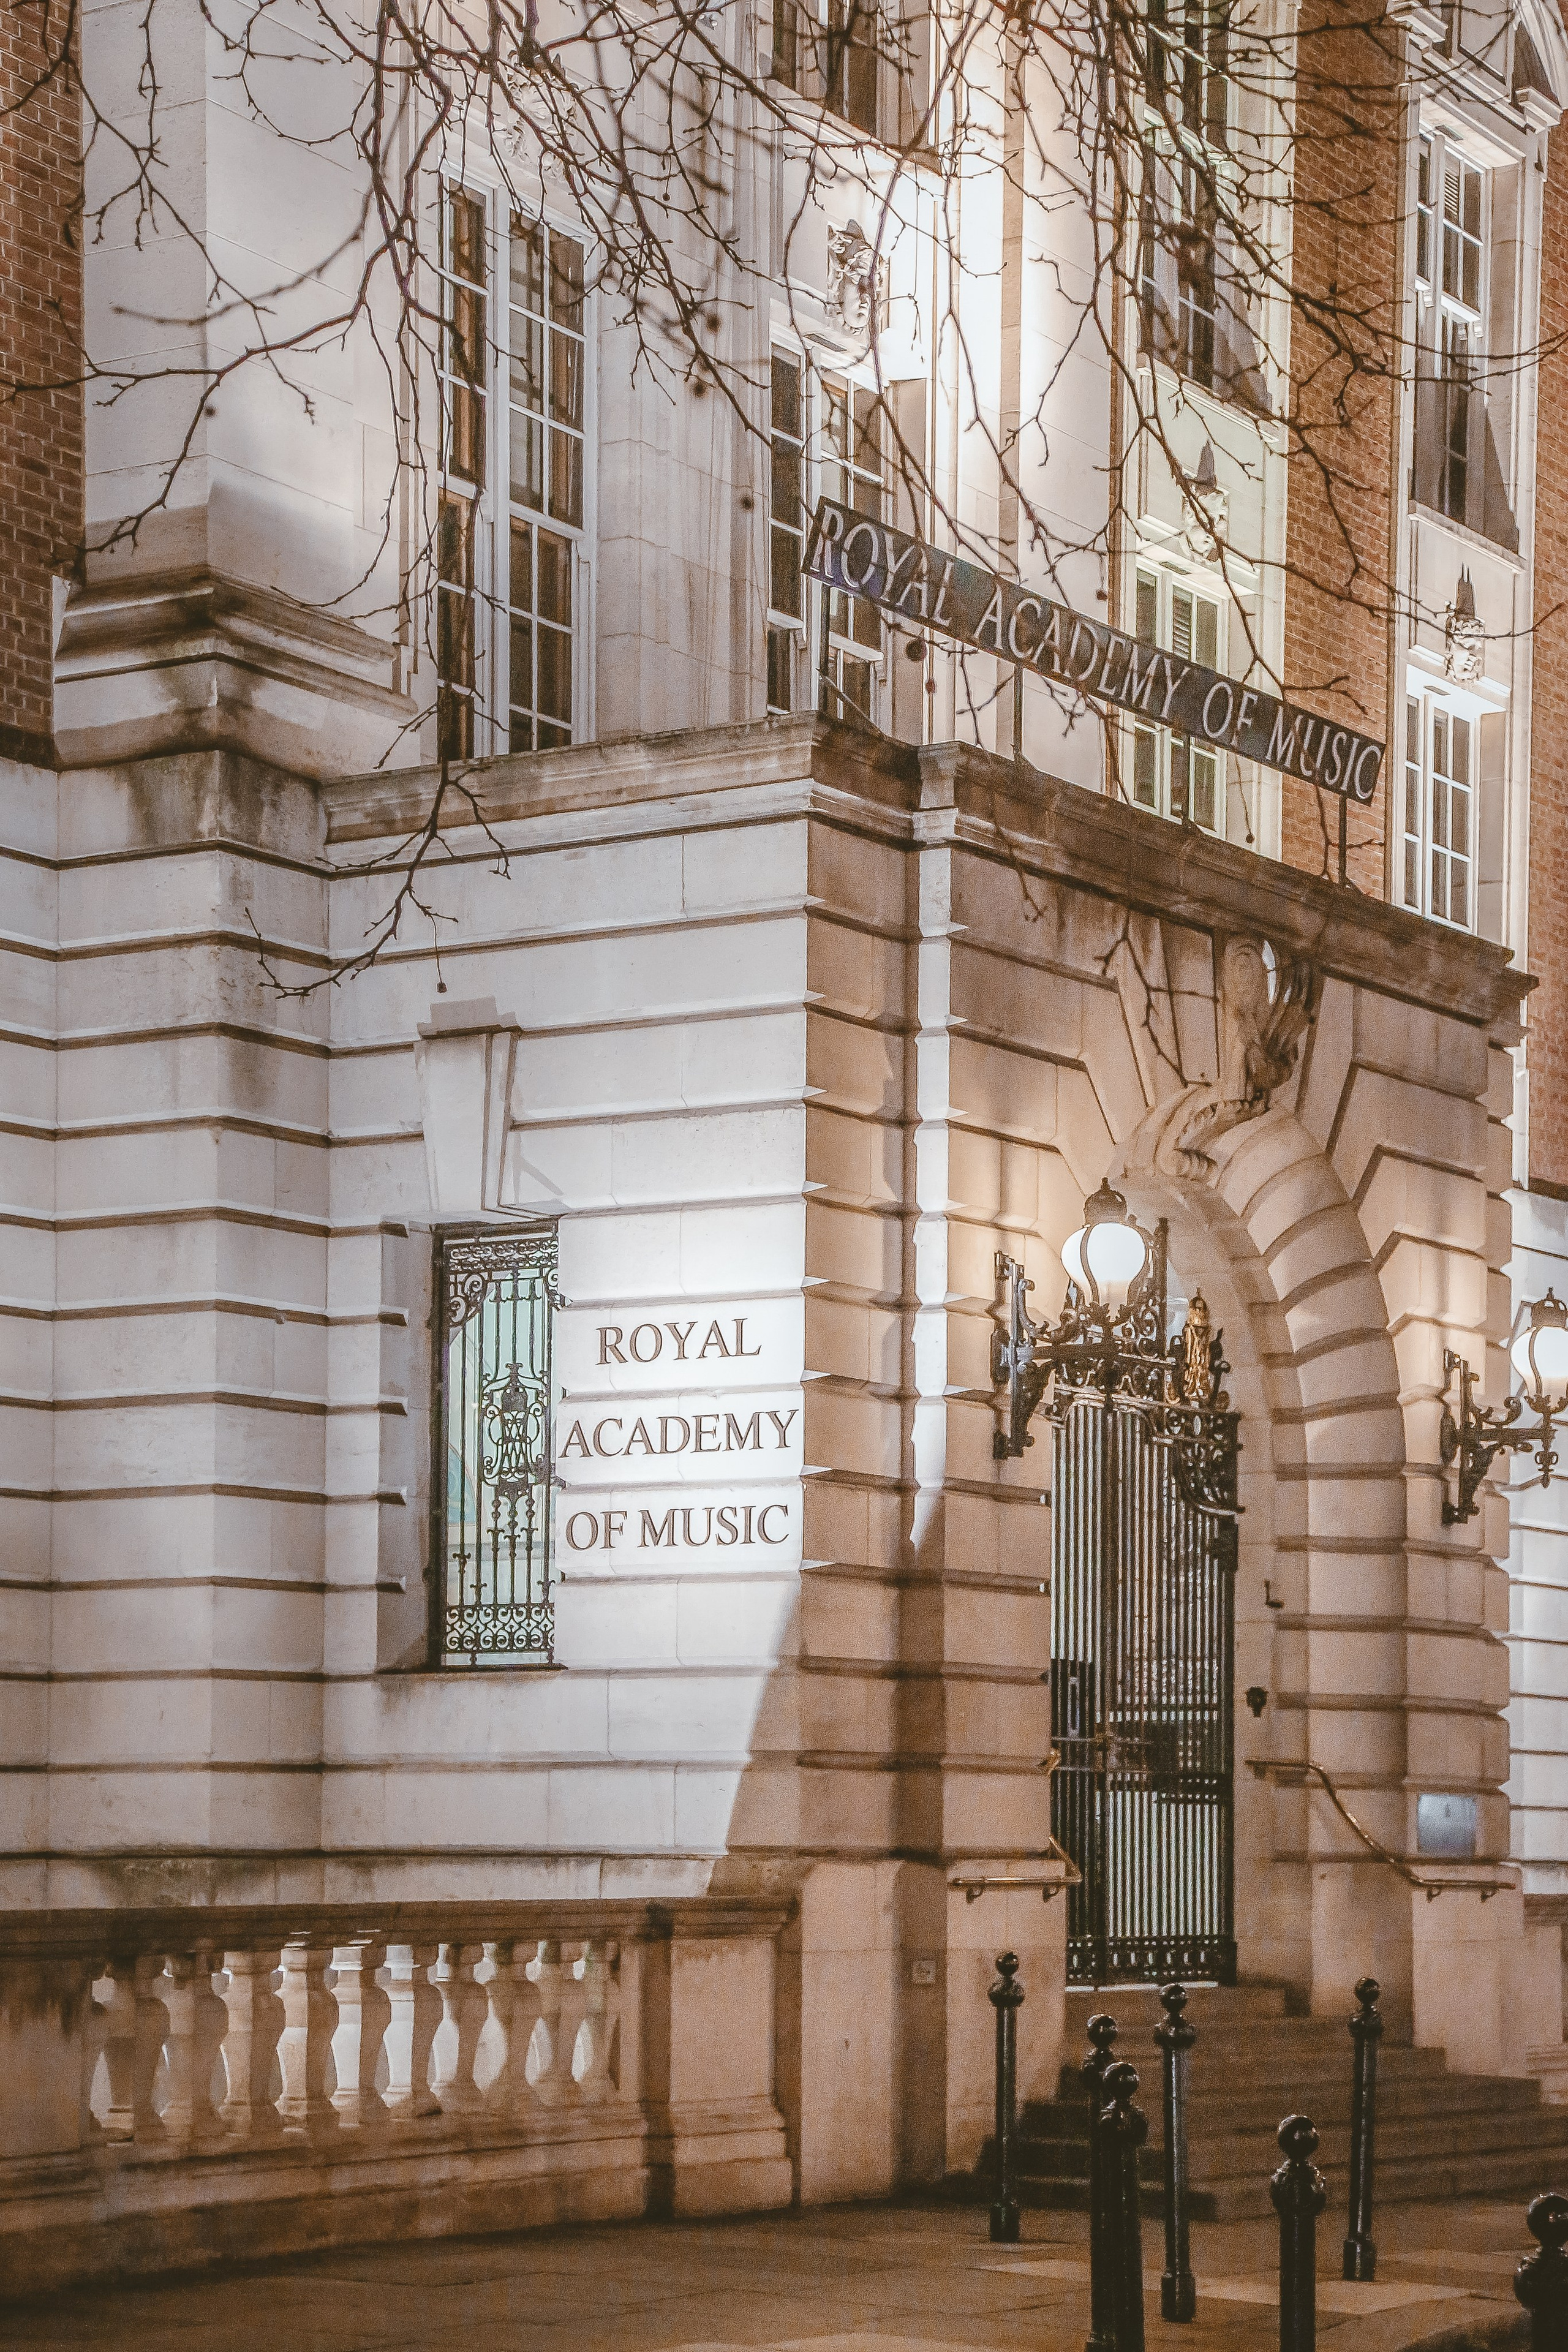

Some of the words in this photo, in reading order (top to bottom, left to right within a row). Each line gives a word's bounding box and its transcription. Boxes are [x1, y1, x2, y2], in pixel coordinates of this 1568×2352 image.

[810, 505, 956, 625] ROYAL
[973, 581, 1189, 719] ACADEMY
[1202, 681, 1257, 745] OF
[1265, 705, 1382, 799] MUSIC
[595, 1317, 762, 1366] ROYAL
[558, 1409, 799, 1459] ACADEMY
[565, 1509, 628, 1551] OF
[637, 1504, 790, 1548] MUSIC
